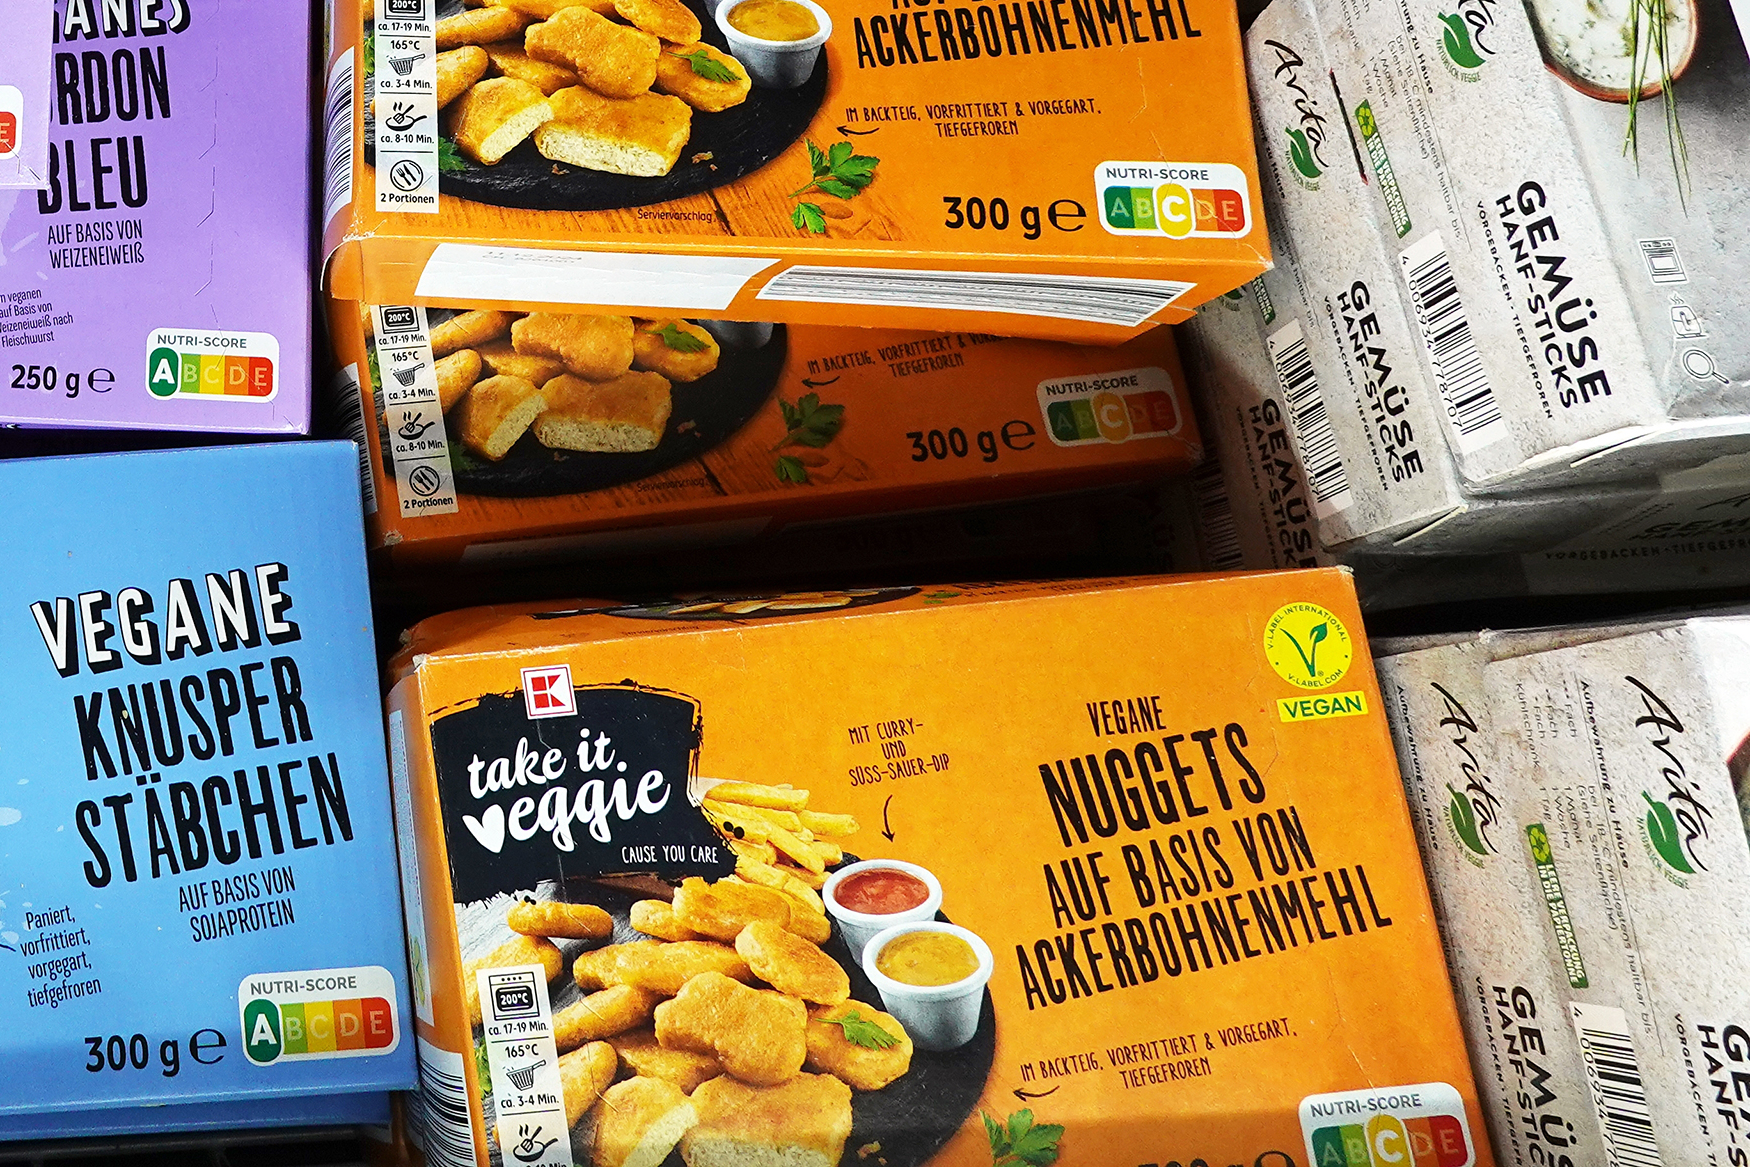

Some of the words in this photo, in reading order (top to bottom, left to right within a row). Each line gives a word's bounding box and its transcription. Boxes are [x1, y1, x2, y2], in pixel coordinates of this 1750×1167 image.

[846, 107, 858, 121] IM
[925, 102, 1007, 120] VORFRITTIERT
[1015, 102, 1024, 116] &
[637, 209, 712, 224] Serviervorschlag
[1495, 195, 1578, 409] HANF-STICKS
[1516, 180, 1612, 404] GEMÜSE
[1337, 292, 1405, 484] HANF-STICKS
[1350, 280, 1424, 479] GEMÜSE
[30, 562, 302, 678] VEGANE
[73, 655, 313, 781] KNUSPER
[1087, 696, 1166, 737] VEGANE
[468, 736, 566, 798] take
[1038, 722, 1266, 847] NUGGETS
[75, 752, 353, 887] STÄBCHEN
[622, 846, 658, 864] CAUSE
[662, 846, 686, 863] YOU
[690, 844, 718, 863] CARE
[19, 927, 91, 959] vorfrittiert,
[25, 906, 76, 929] Paniert,
[190, 899, 295, 943] SOJAPROTEIN
[1015, 865, 1391, 1010] ACKERBOHNENMEHL
[27, 952, 92, 980] vorgegart,
[27, 977, 101, 1008] tiefgefroren
[1310, 1093, 1422, 1118] NUTRI-SCORE
